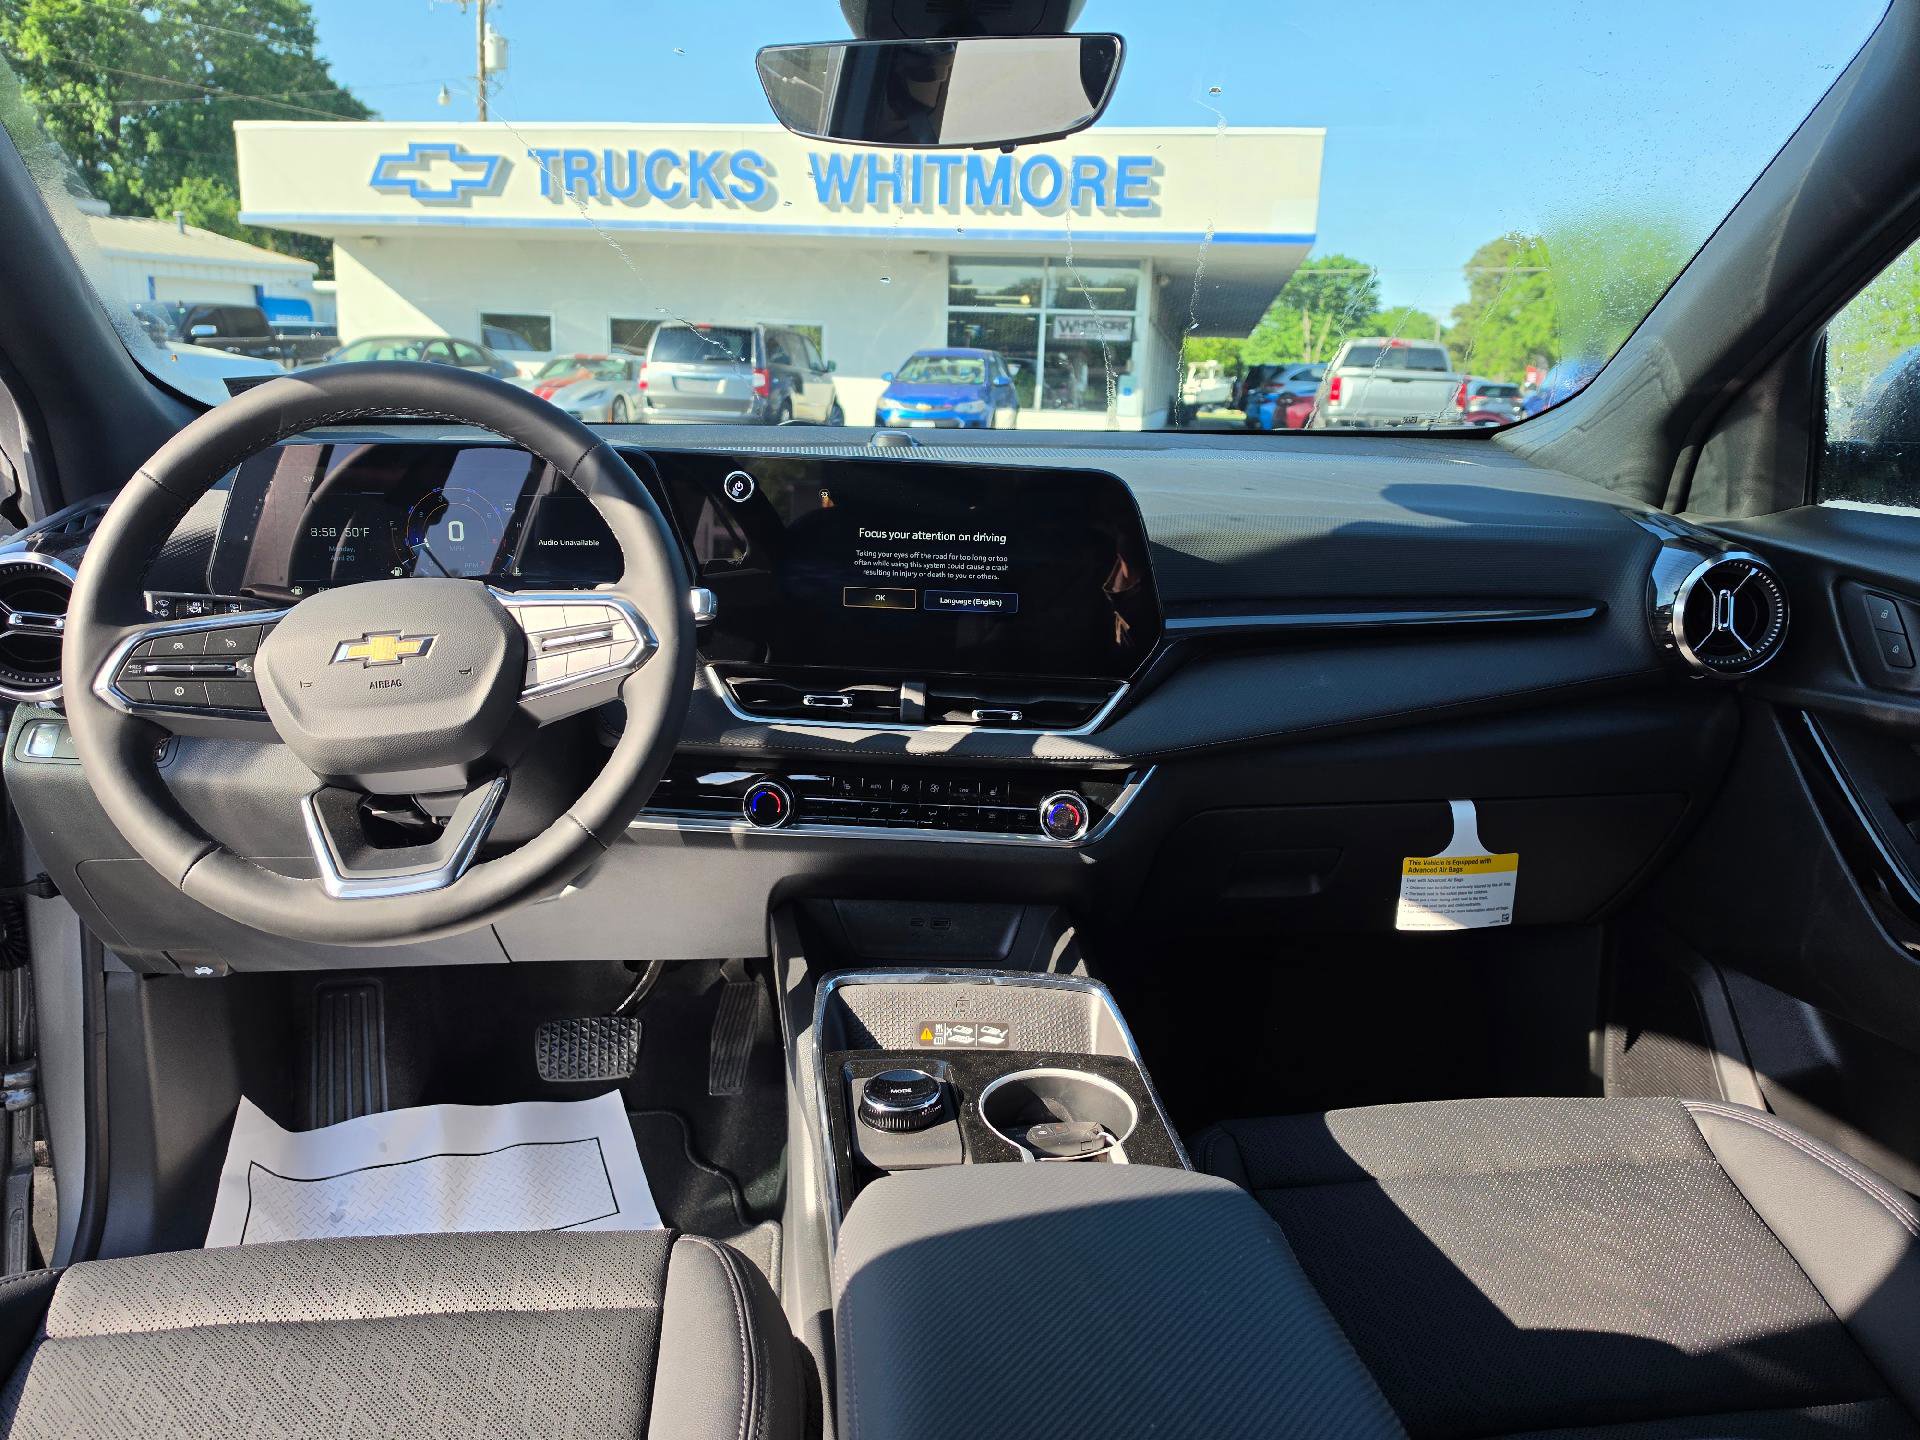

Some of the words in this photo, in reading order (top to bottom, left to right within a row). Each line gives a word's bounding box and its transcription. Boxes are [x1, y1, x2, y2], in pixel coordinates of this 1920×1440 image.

[527, 148, 768, 202] TRUCKS
[808, 152, 1154, 208] WHITMORE
[310, 527, 337, 537] 8:58
[448, 520, 464, 541] 0
[859, 527, 887, 539] Focus
[888, 531, 910, 540] your
[911, 531, 956, 541] attention
[958, 533, 971, 541] on
[973, 531, 1007, 545] driving
[856, 549, 877, 559] Taking
[877, 551, 893, 559] your
[909, 551, 920, 559] off
[932, 553, 948, 561] road
[948, 553, 959, 561] for
[959, 553, 971, 561] too
[971, 554, 987, 563] long
[863, 569, 891, 578] resulting
[899, 570, 918, 579] injury
[927, 570, 946, 578] death
[976, 572, 1000, 580] others.
[939, 597, 972, 606] Language
[972, 598, 1003, 607] (English)
[369, 678, 402, 690] AIRBAG
[1449, 866, 1463, 874] Bags
